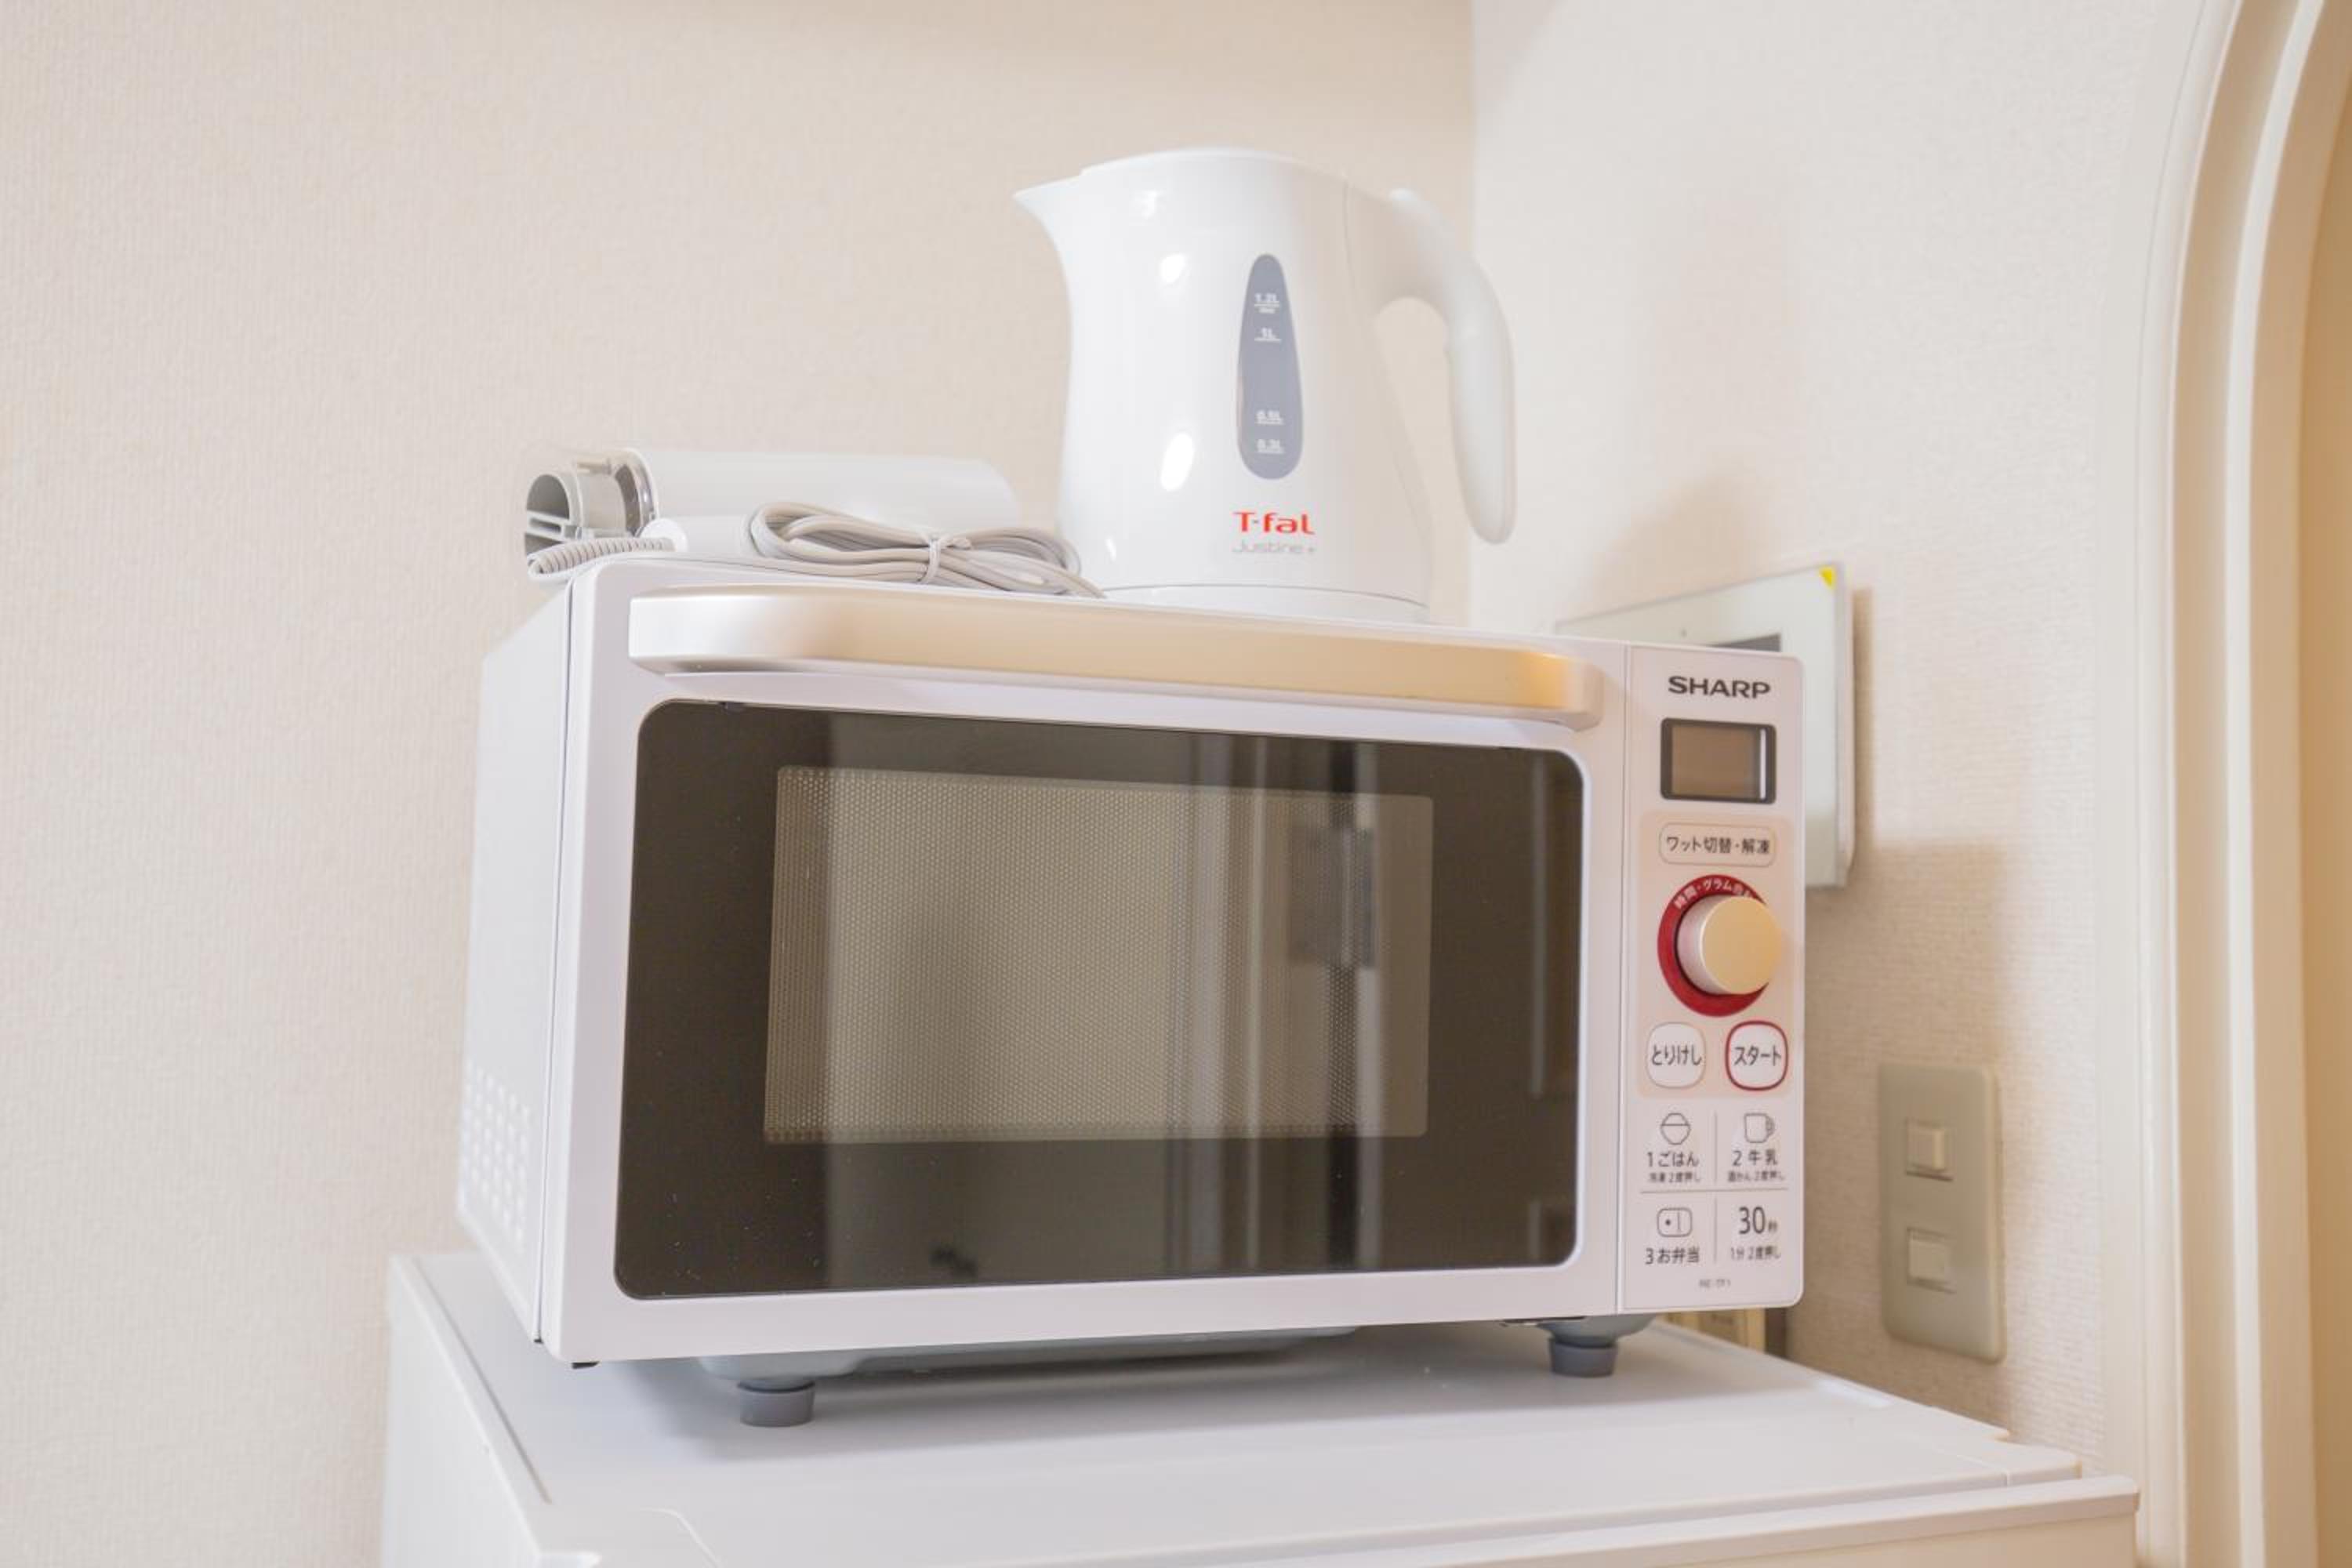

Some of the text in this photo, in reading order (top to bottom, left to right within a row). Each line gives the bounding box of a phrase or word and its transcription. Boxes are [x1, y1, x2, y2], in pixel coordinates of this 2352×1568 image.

[1232, 510, 1316, 535] T-fal
[1668, 676, 1771, 699] SHARP
[1666, 837, 1769, 855] ワット切替・解凍
[1651, 1044, 1703, 1066] とりけし
[1733, 1044, 1782, 1066] スタート
